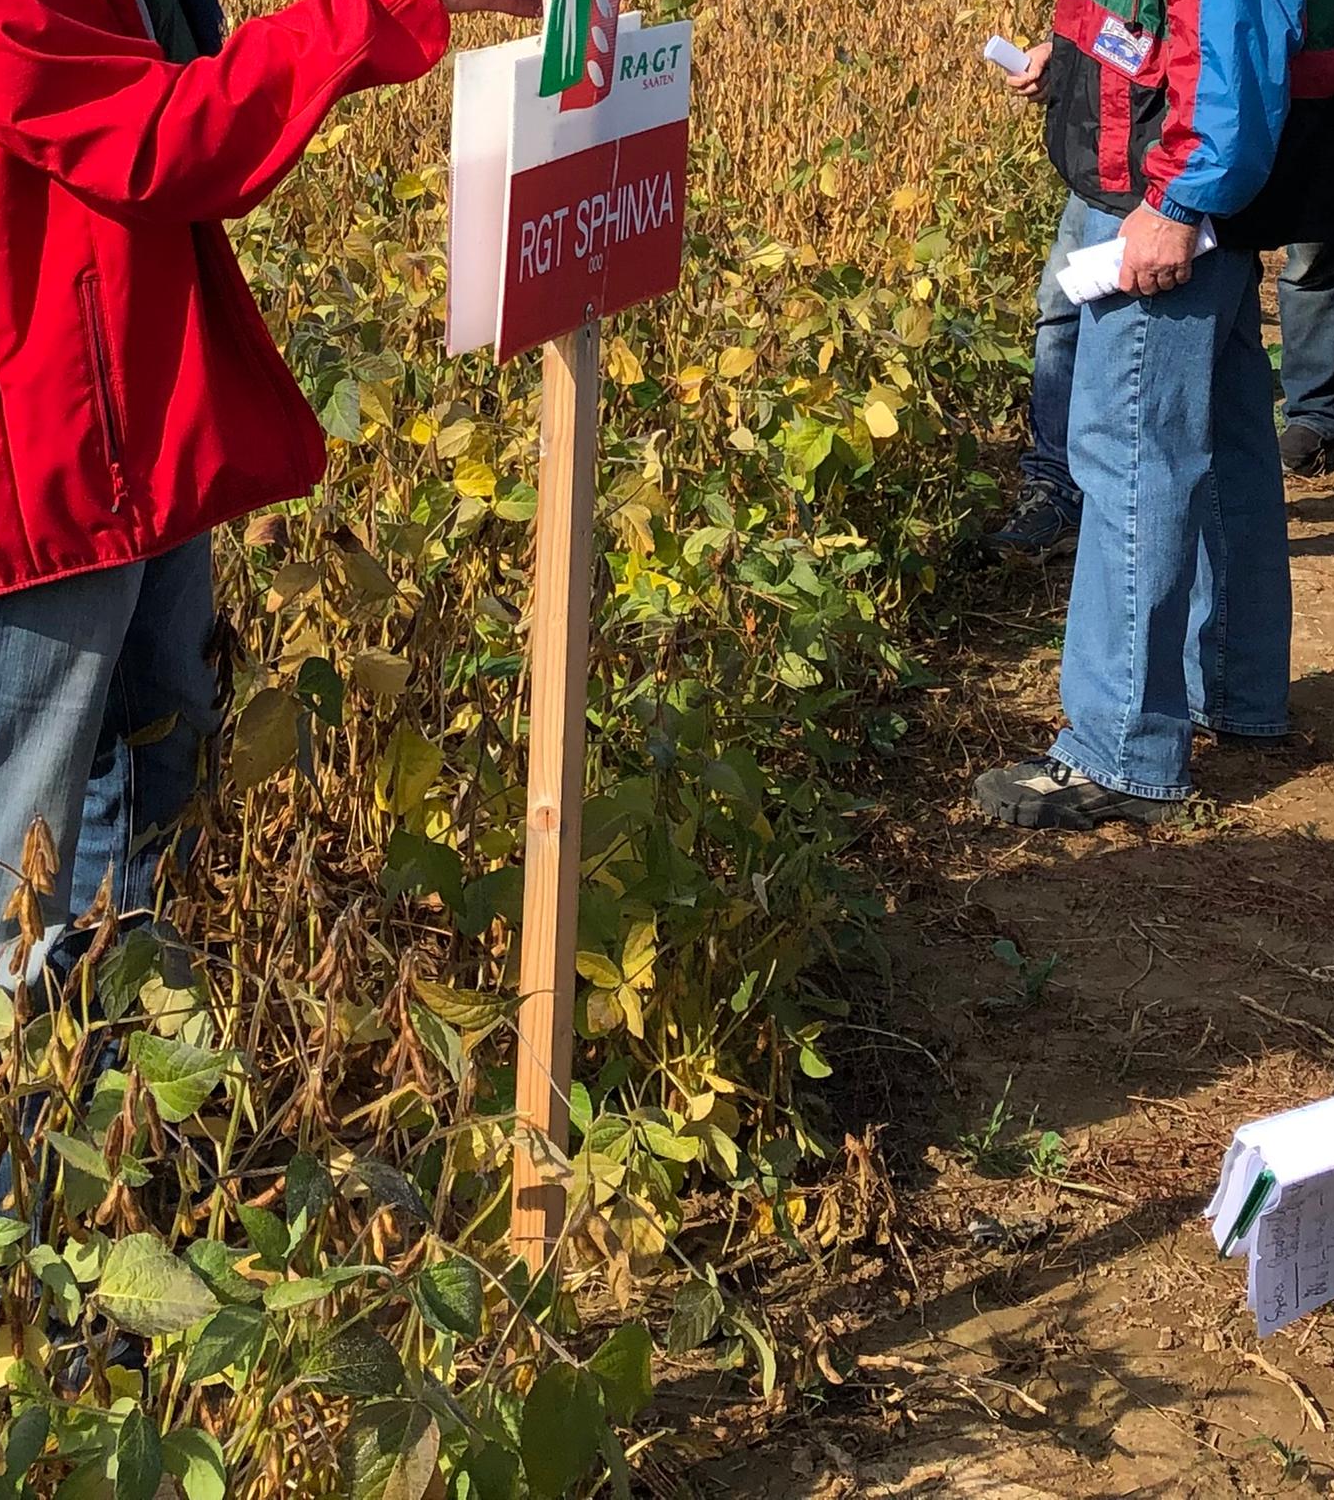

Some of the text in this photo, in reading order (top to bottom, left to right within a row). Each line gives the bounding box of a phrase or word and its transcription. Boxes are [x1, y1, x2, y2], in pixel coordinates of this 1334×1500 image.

[642, 73, 675, 90] SAATEN
[519, 171, 674, 283] RGT SPHINXA
